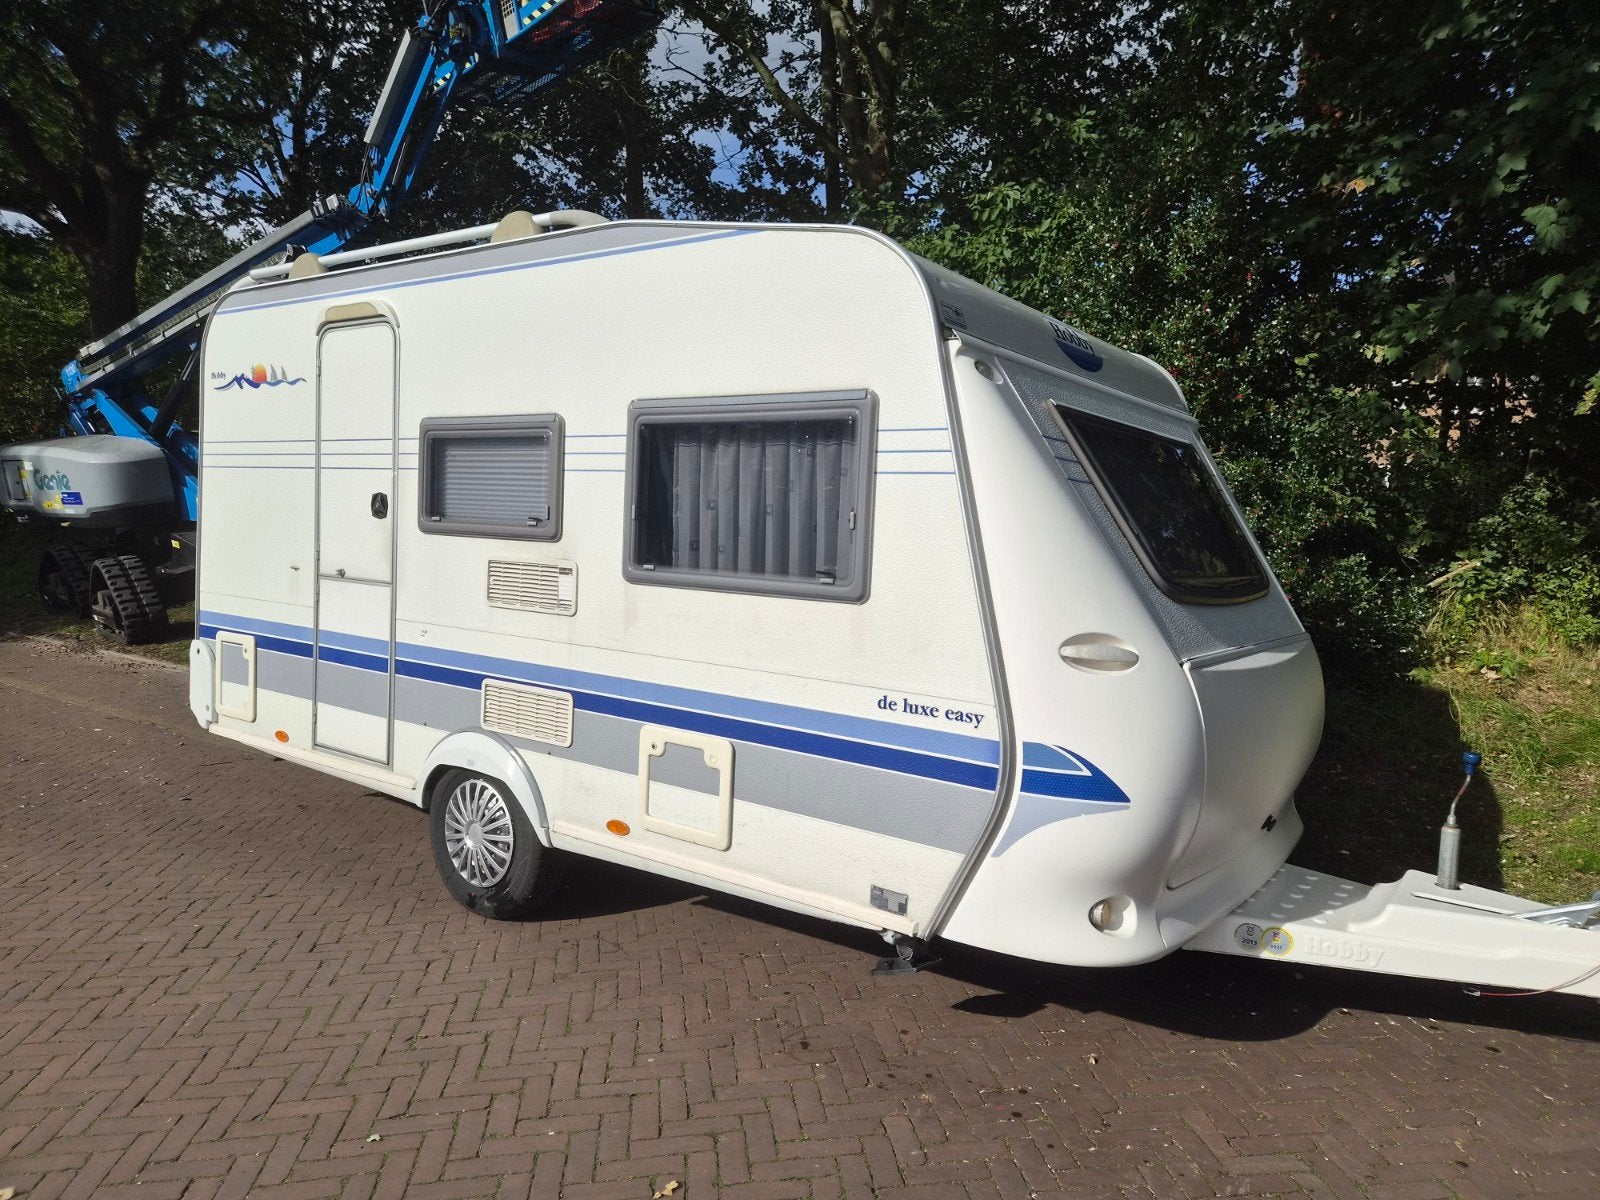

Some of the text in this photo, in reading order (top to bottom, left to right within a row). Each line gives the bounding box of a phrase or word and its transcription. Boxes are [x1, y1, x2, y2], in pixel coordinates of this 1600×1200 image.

[1049, 321, 1095, 357] Hobby
[34, 469, 71, 490] Genie
[877, 695, 984, 729] de luxe easy
[1305, 936, 1385, 968] Hobby
